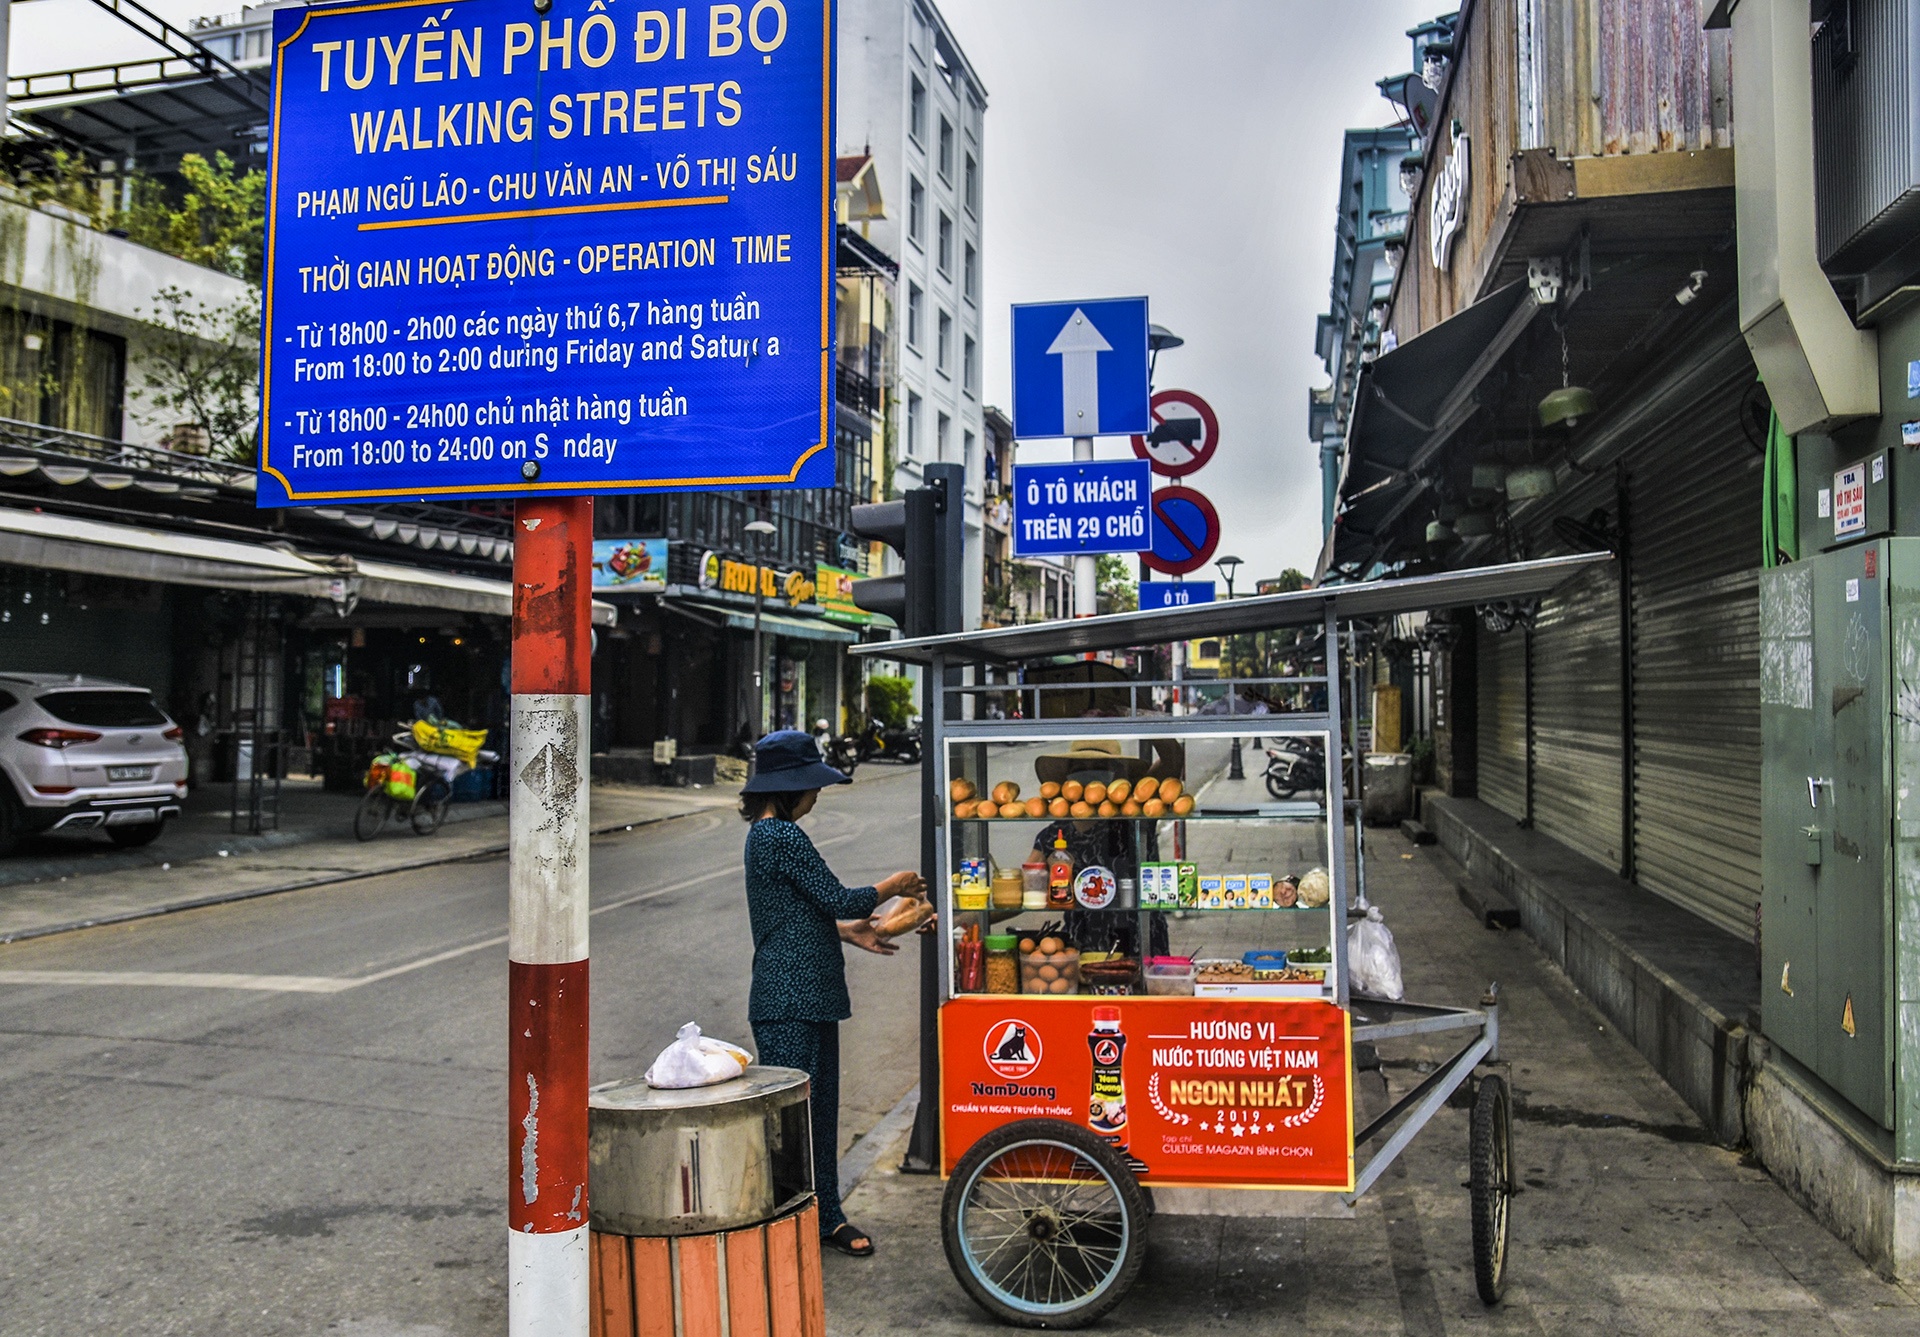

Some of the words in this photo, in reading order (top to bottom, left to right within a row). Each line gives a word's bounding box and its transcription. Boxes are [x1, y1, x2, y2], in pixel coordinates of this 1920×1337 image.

[312, 8, 482, 92] TUYẾN
[633, 7, 687, 63] ĐI
[349, 97, 533, 155] WALKING
[548, 80, 742, 140] STREETS
[297, 186, 359, 220] PHẠM
[366, 175, 415, 212] NGŨ
[422, 177, 467, 208] LÃO
[488, 171, 537, 203] CHU
[544, 161, 592, 197] VĂN
[599, 164, 633, 194] AN
[656, 153, 690, 189] VÕ
[696, 157, 737, 191] THỊ
[746, 145, 797, 184] SÁU
[298, 255, 350, 294] THỜI
[357, 258, 411, 289] GIAN
[418, 253, 481, 289] HOẠT
[486, 243, 555, 286] ĐỘNG
[577, 237, 715, 274] OPERATION
[731, 234, 791, 265] TIME
[296, 321, 324, 349] Từ
[328, 319, 388, 347] 18h00
[407, 314, 457, 341] 2h00
[463, 310, 500, 337] các
[506, 306, 559, 340] ngày
[565, 302, 603, 331] thứ
[607, 302, 640, 332] 6,7
[647, 298, 703, 330] hàng
[710, 291, 760, 322] tuần
[294, 358, 344, 382] From
[352, 351, 406, 378] 18:00
[411, 351, 433, 374] to
[438, 346, 482, 373] 2:00
[489, 342, 558, 373] during
[566, 338, 635, 369] Friday
[641, 334, 683, 361] and
[295, 408, 323, 435] Từ
[327, 406, 387, 433] 18h00
[406, 402, 469, 429] 24h00
[475, 395, 514, 426] chủ
[521, 396, 570, 428] nhật
[576, 393, 631, 425] hàng
[638, 386, 687, 418] tuần
[293, 444, 343, 469] From
[351, 439, 405, 465] 18:00
[410, 439, 432, 463] to
[437, 435, 494, 462] 24:00
[501, 439, 527, 460] on
[534, 432, 618, 465] Snday
[1027, 478, 1040, 505] Ô
[1044, 477, 1068, 505] TÔ
[1073, 475, 1137, 504] KHÁCH
[1843, 472, 1855, 485] TBA
[1022, 512, 1072, 541] TRÊN
[1077, 516, 1100, 539] 29
[1106, 505, 1144, 538] CHỖ
[1164, 589, 1172, 606] Ô
[1175, 589, 1189, 605] TÔ
[1190, 1020, 1252, 1040] HƯƠNG
[1257, 1022, 1275, 1043] VỊ
[1152, 1045, 1193, 1067] NƯỚC
[1196, 1048, 1245, 1068] TƯƠNG
[1249, 1046, 1282, 1071] VIỆT
[1285, 1050, 1318, 1068] NAM
[1170, 1079, 1235, 1106] NGON
[1240, 1075, 1307, 1107] NHẤT
[1162, 1144, 1204, 1154] CULTURE
[1206, 1144, 1253, 1156] MAGAZIN
